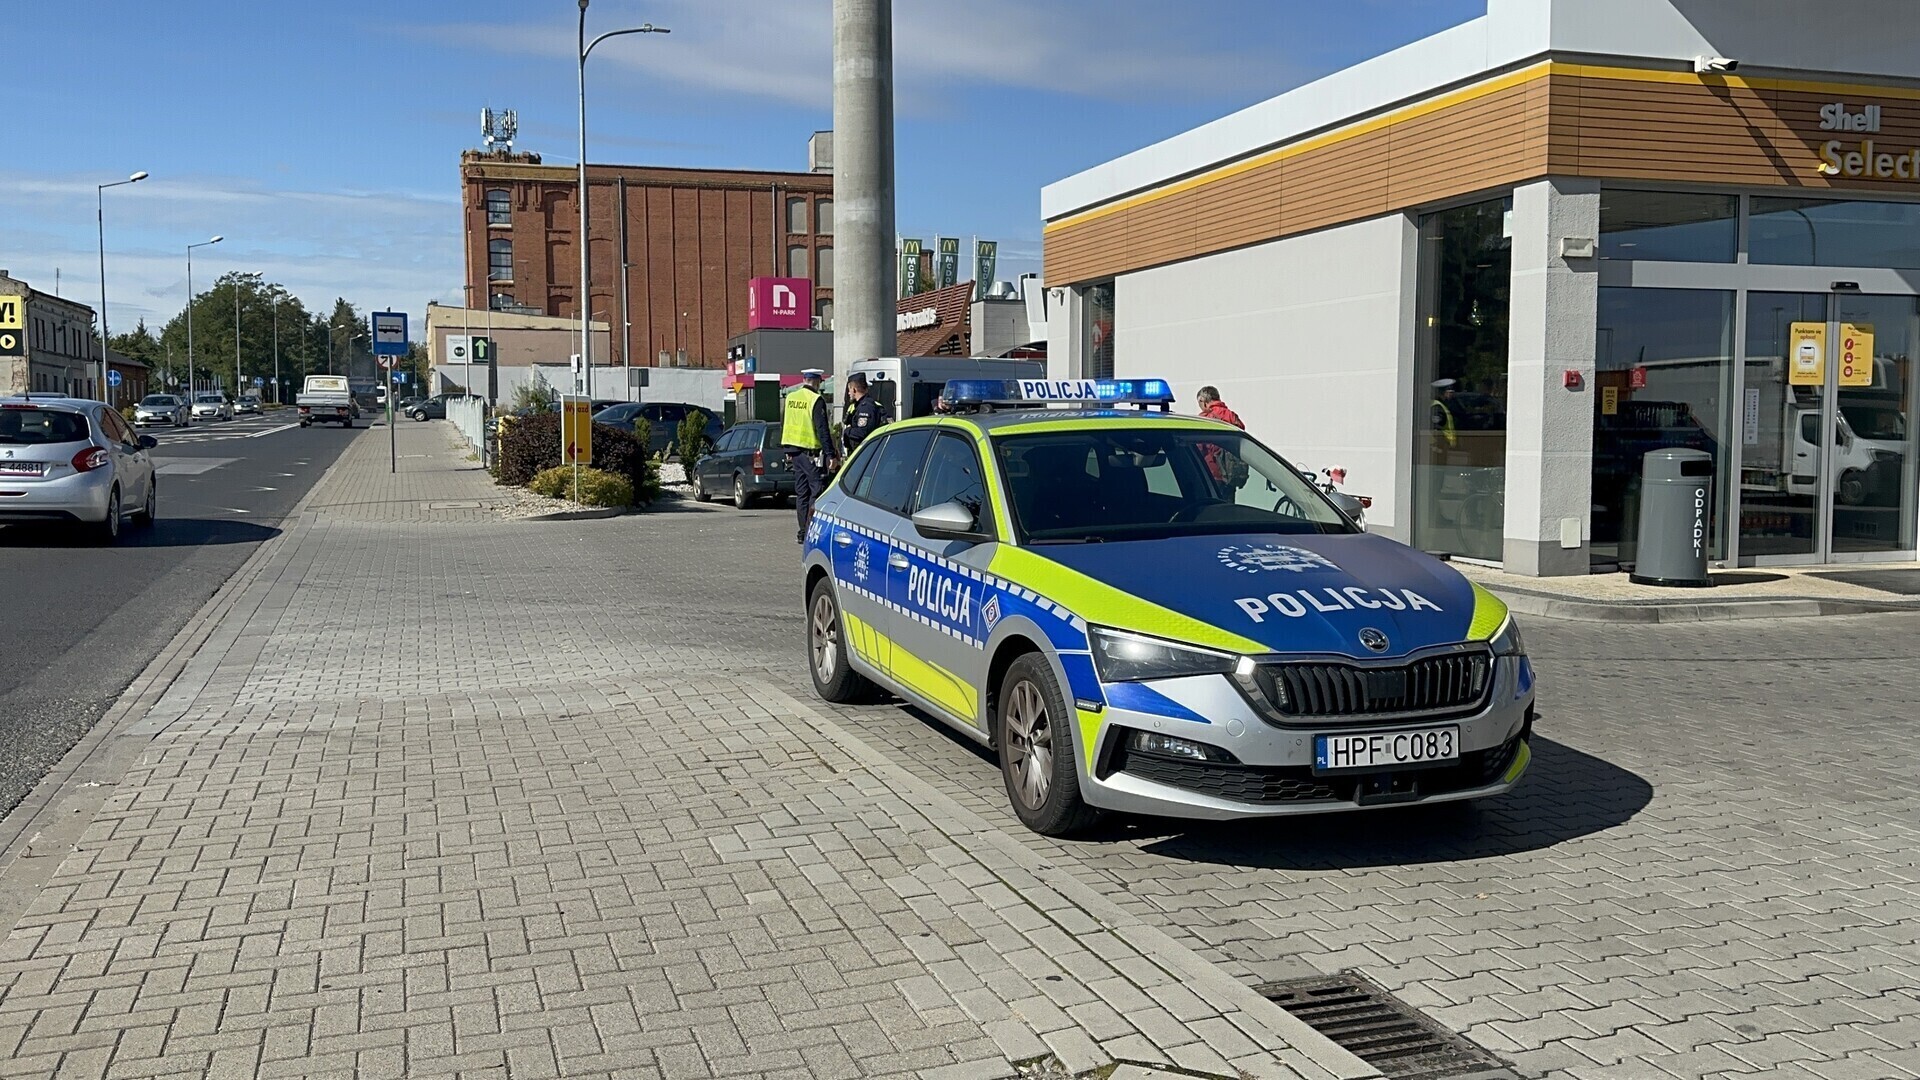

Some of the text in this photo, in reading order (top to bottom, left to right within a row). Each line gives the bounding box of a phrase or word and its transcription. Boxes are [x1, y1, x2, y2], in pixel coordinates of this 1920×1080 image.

[1819, 103, 1880, 131] Shell
[1023, 381, 1097, 399] POLICJA
[565, 404, 589, 415] Wyazd
[788, 400, 808, 410] POLICJA
[9, 463, 40, 472] 44881
[1693, 488, 1705, 558] ODPADKI
[908, 564, 971, 628] POLICJA
[1233, 587, 1444, 623] POLICJA
[1317, 756, 1327, 764] PL
[1334, 731, 1452, 766] HPF C083
